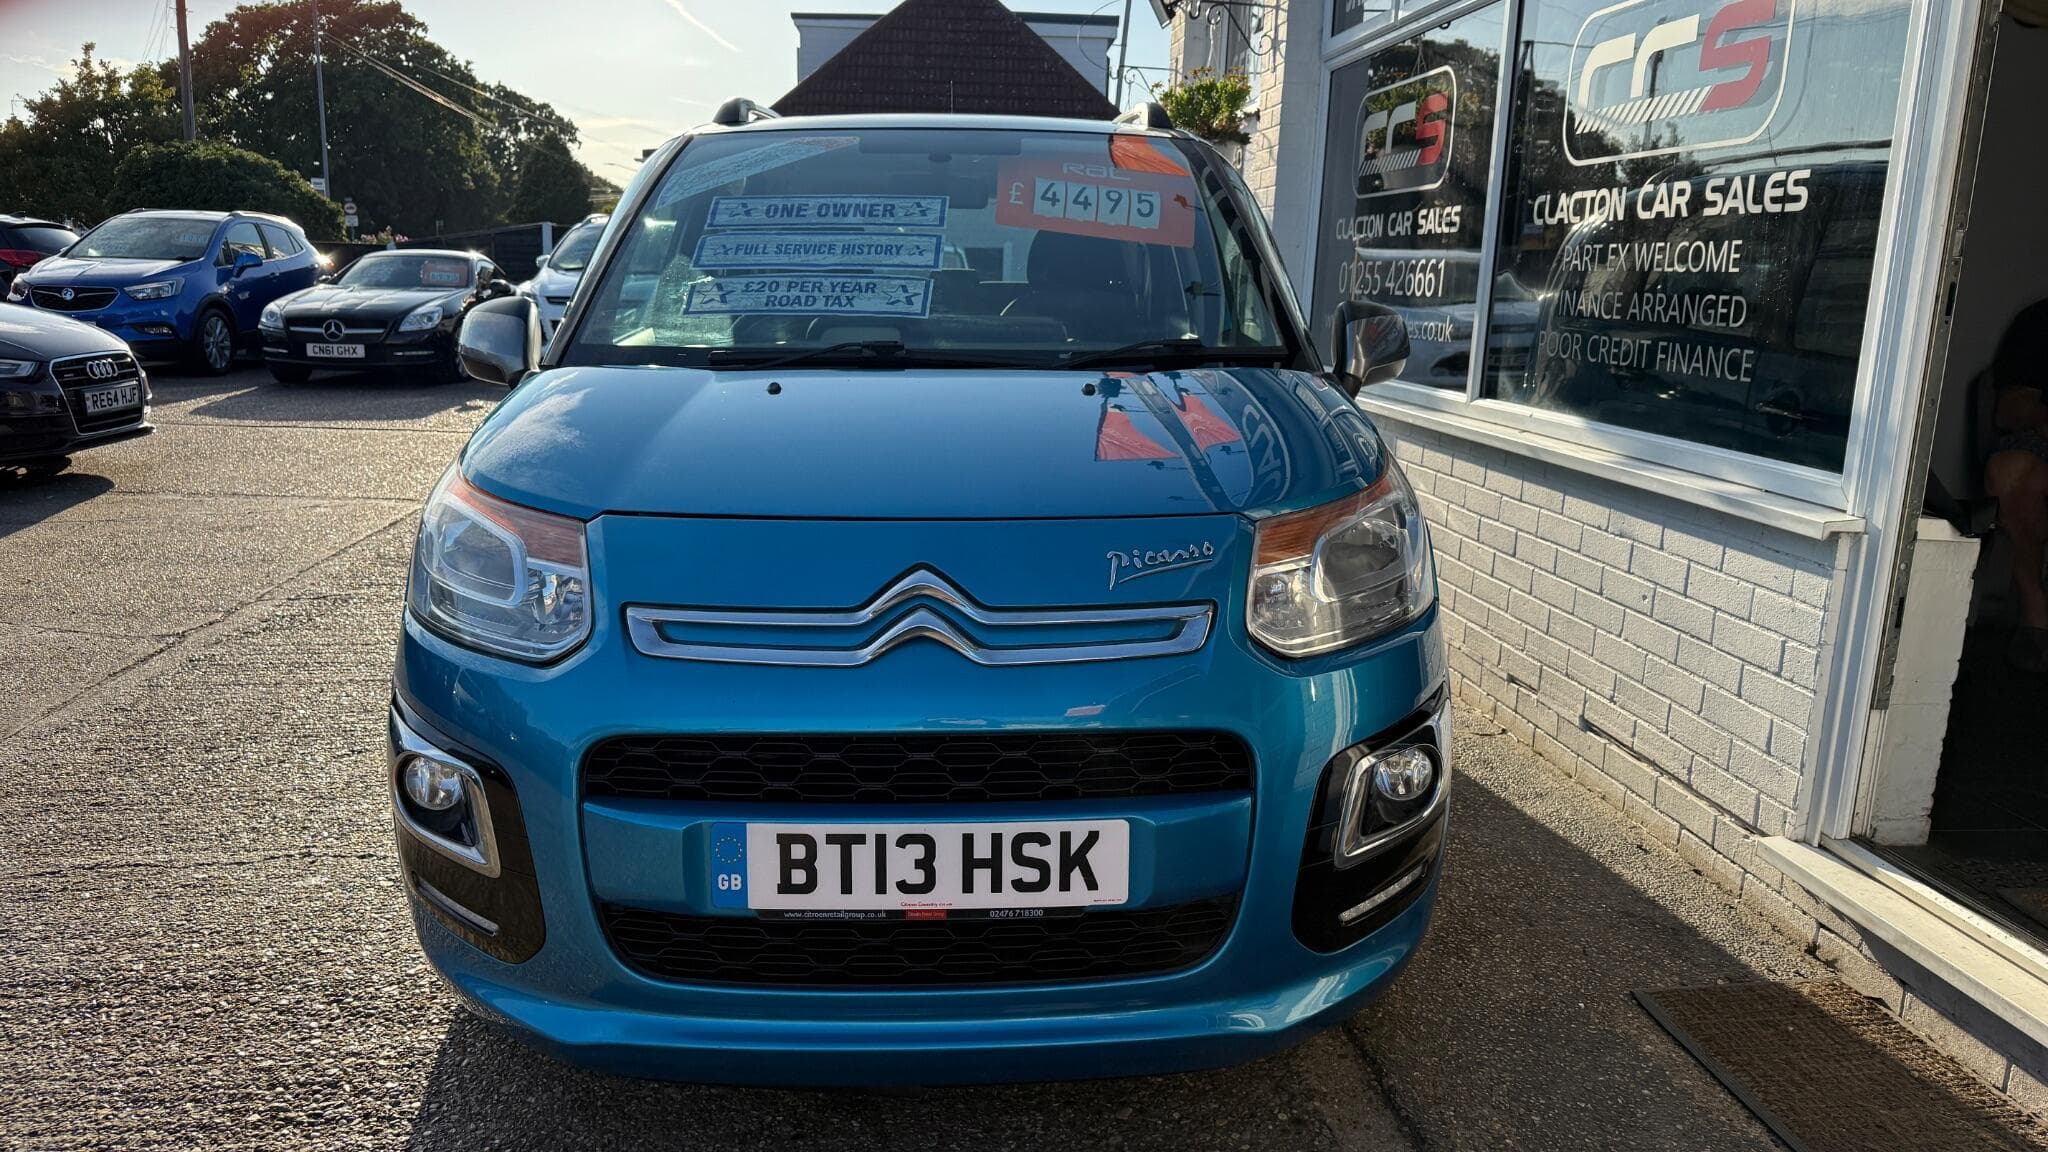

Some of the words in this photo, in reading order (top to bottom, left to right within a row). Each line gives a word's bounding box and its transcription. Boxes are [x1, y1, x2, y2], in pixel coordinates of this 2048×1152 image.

[764, 203, 809, 219] ONE
[816, 203, 896, 219] OWNER
[1040, 182, 1155, 218] 4495
[1533, 186, 1627, 226] CLACTON
[1636, 180, 1692, 220] CAR
[1702, 168, 1812, 216] SALES
[1335, 213, 1384, 241] CLACTON
[1387, 210, 1413, 237] CAR
[1416, 204, 1462, 235] SALES
[733, 243, 770, 256] FULL
[773, 243, 836, 256] SERVICE
[840, 244, 904, 257] HISTORY
[1562, 244, 1604, 273] PART
[1606, 243, 1630, 272] EX
[1635, 239, 1743, 273] WELCOME
[741, 281, 780, 293] £20
[786, 281, 824, 293] PER
[827, 282, 877, 294] YEAR
[1338, 260, 1382, 296] 01255
[1384, 257, 1446, 299] 426661
[764, 295, 817, 308] ROAD
[821, 295, 856, 308] TAX
[1627, 290, 1748, 328] ARRANGED
[336, 346, 358, 356] GHX
[1538, 331, 1582, 361] POOR
[1586, 334, 1652, 369] CREDIT
[1655, 341, 1755, 383] FINANCE
[91, 392, 120, 411] RE64
[121, 386, 138, 404] HJF
[776, 832, 937, 896] BT13
[961, 830, 1101, 894] HSK
[718, 874, 743, 892] GB
